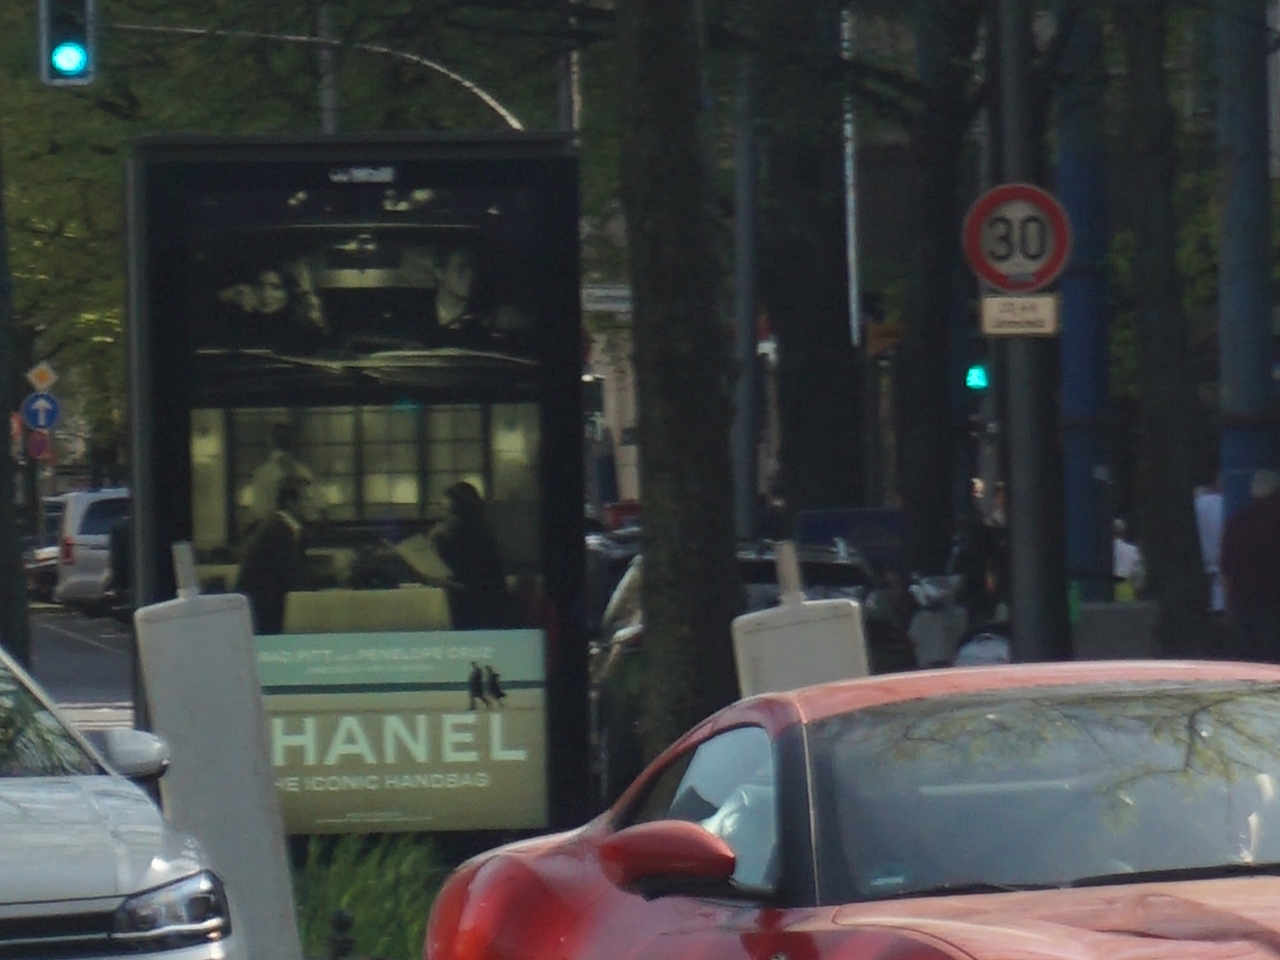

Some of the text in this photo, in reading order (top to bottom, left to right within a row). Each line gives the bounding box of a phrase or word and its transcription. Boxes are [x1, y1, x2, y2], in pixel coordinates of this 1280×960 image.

[987, 215, 1047, 261] 30
[305, 774, 380, 791] ICONIC
[384, 773, 490, 789] HANDBAG
